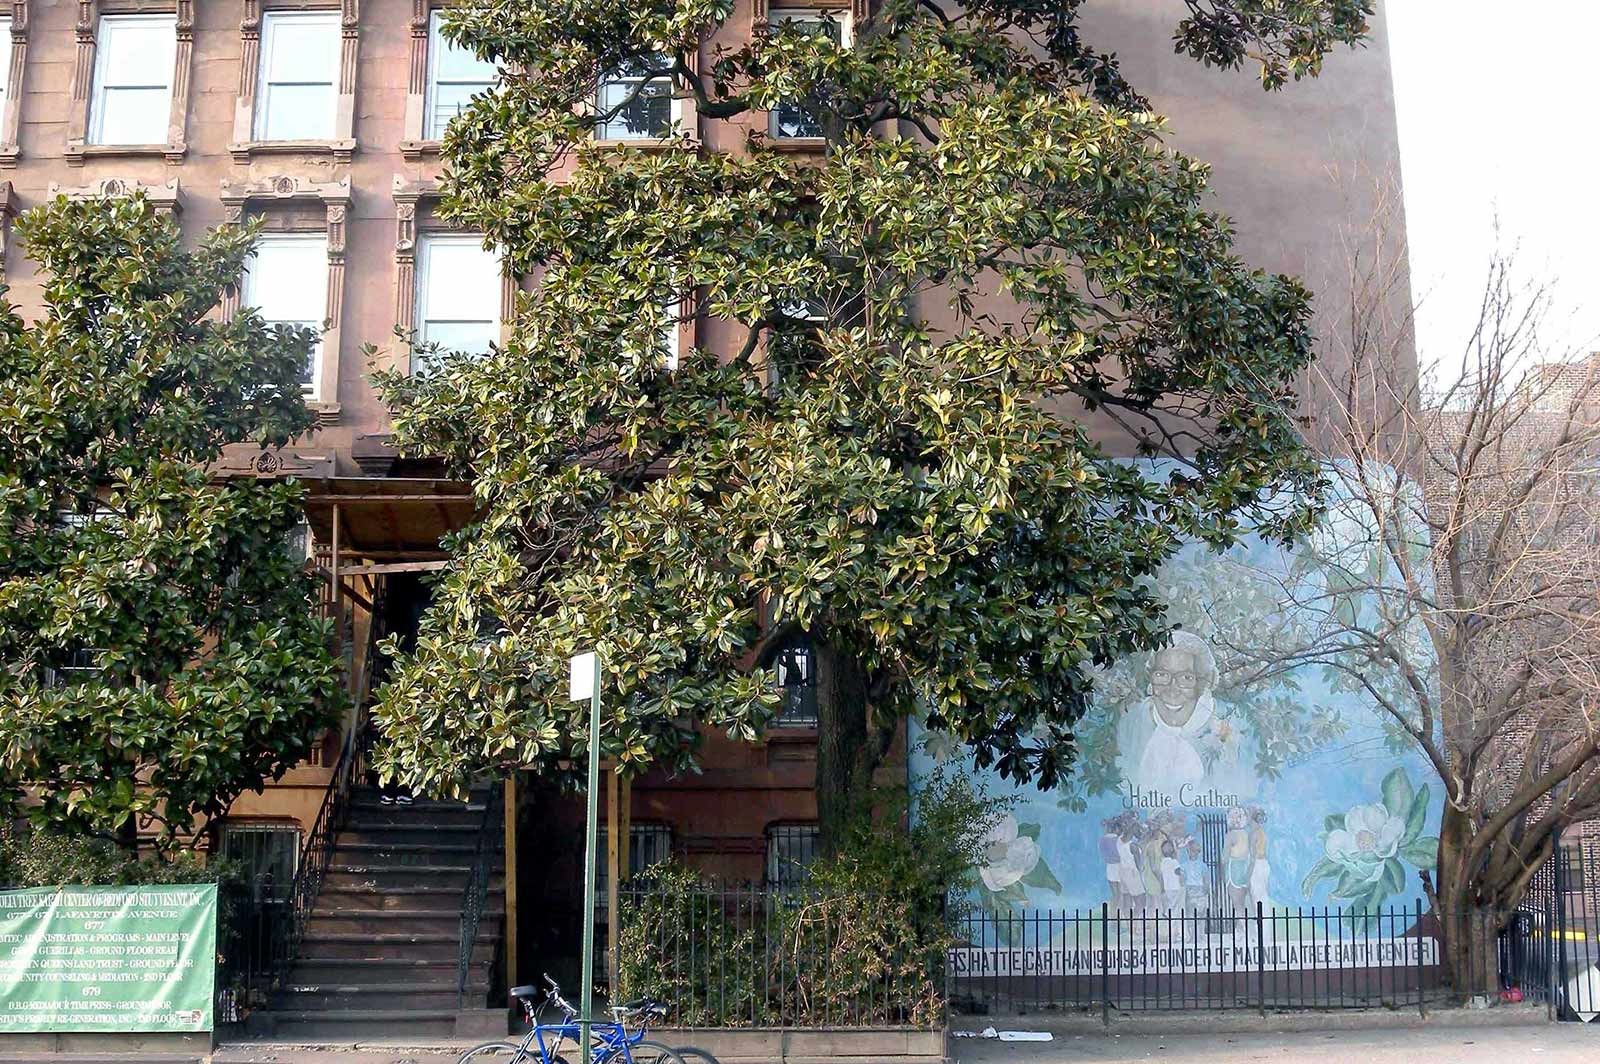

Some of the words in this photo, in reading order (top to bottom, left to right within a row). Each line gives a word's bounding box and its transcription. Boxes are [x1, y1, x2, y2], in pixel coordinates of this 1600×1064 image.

[1118, 777, 1172, 809] Hattie
[1179, 782, 1239, 808] Carthan
[18, 895, 38, 907] TREE
[38, 894, 63, 907] EARH
[63, 893, 92, 907] CENTER
[55, 911, 124, 919] LAFAYETTE
[128, 910, 178, 919] AVENUE
[84, 920, 105, 930] 677
[24, 933, 89, 943] ADNISTRATION
[95, 933, 141, 943] PROGRAMS
[146, 932, 165, 943] MAIN
[89, 946, 125, 955] GROUND
[126, 946, 154, 955] FLOOR
[155, 946, 178, 955] REAR
[971, 950, 1022, 972] HATTE
[1025, 950, 1090, 972] CARTHAN
[1150, 948, 1211, 968] FOUNDER
[1215, 947, 1231, 967] OF
[1234, 945, 1299, 966] MAGNOLA
[1302, 944, 1332, 964] TREE
[1334, 943, 1374, 963] EARTH
[74, 959, 96, 969] LAND
[97, 959, 124, 969] TRUST
[129, 959, 165, 968] GROUND
[166, 959, 194, 968] FLOR
[98, 973, 139, 982] MEDIATION
[81, 986, 102, 996] 679
